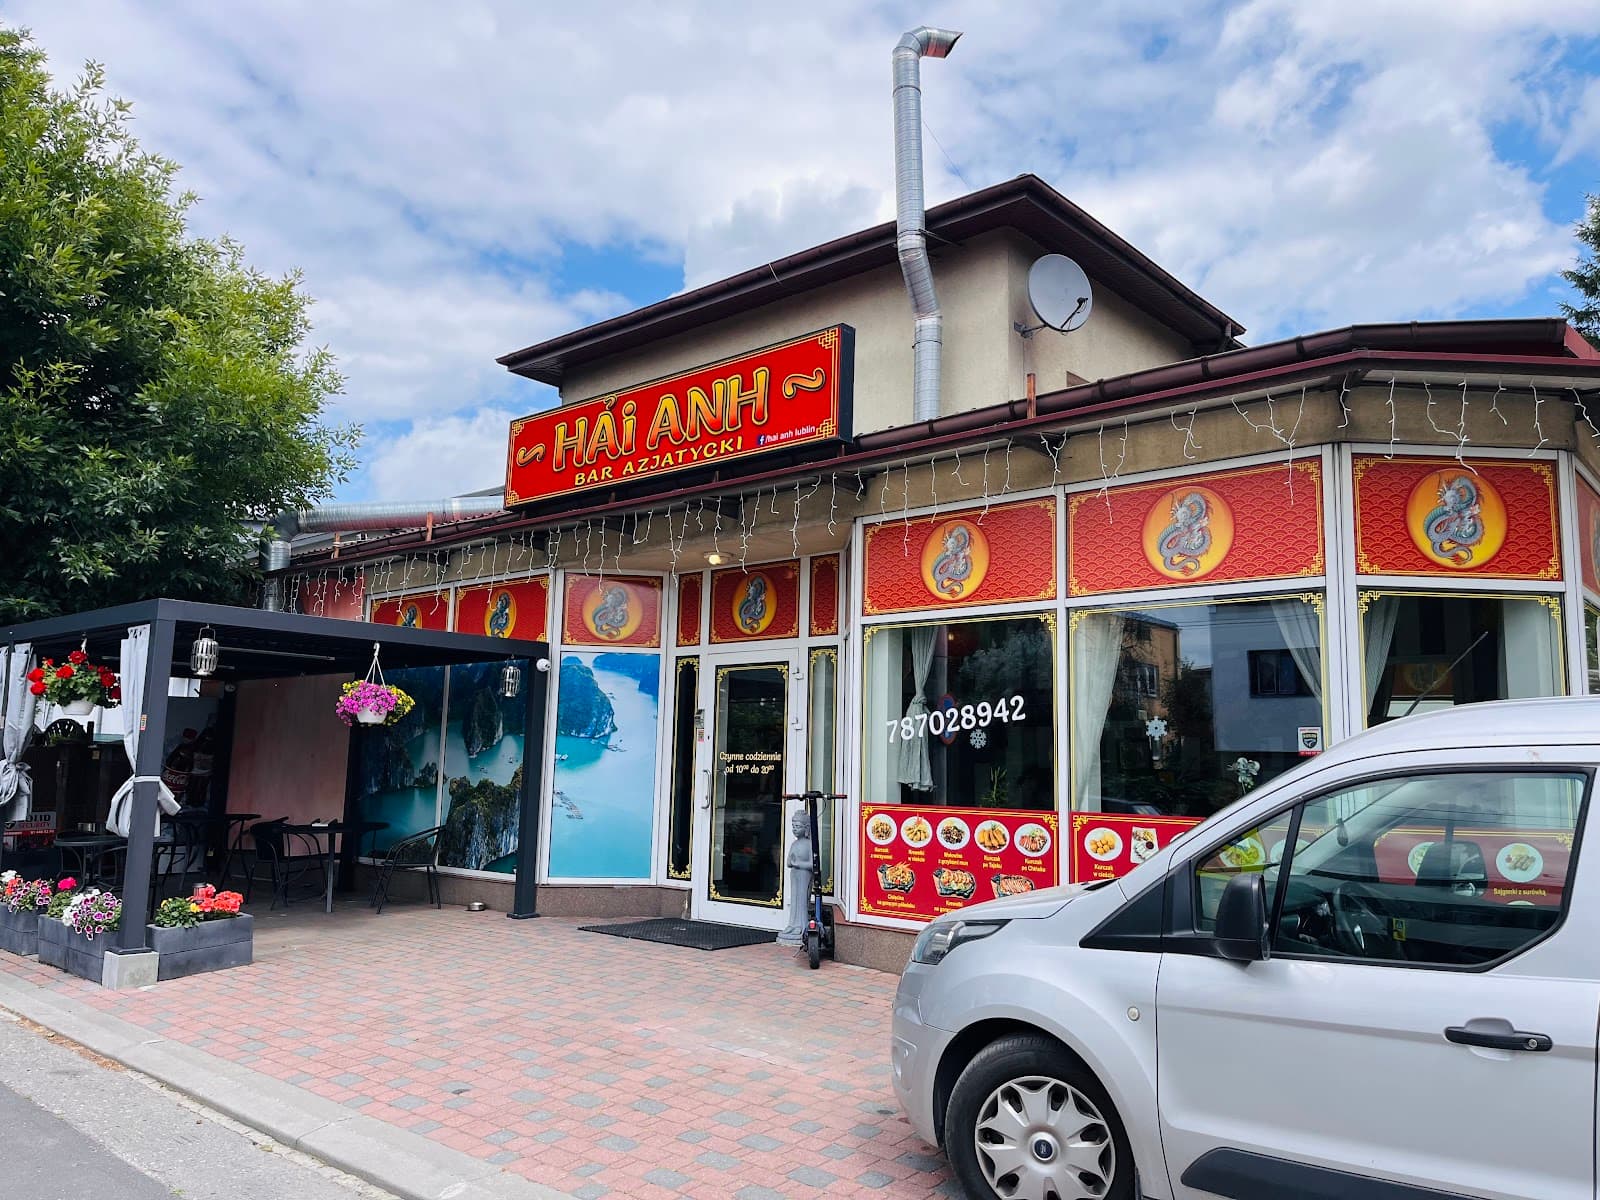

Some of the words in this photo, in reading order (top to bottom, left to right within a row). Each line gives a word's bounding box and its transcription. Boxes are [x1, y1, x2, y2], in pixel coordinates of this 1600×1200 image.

[646, 366, 770, 450] ANH
[779, 428, 795, 441] anh
[794, 424, 817, 438] lublin
[574, 467, 614, 486] BAR
[622, 437, 743, 477] AZJATYCKI
[886, 695, 1026, 743] 787028942
[720, 752, 744, 763] Czynne
[745, 751, 782, 761] codziennie
[725, 763, 735, 774] od
[751, 763, 760, 774] do
[1024, 858, 1043, 866] Kurczak
[1094, 864, 1114, 872] Kurczak
